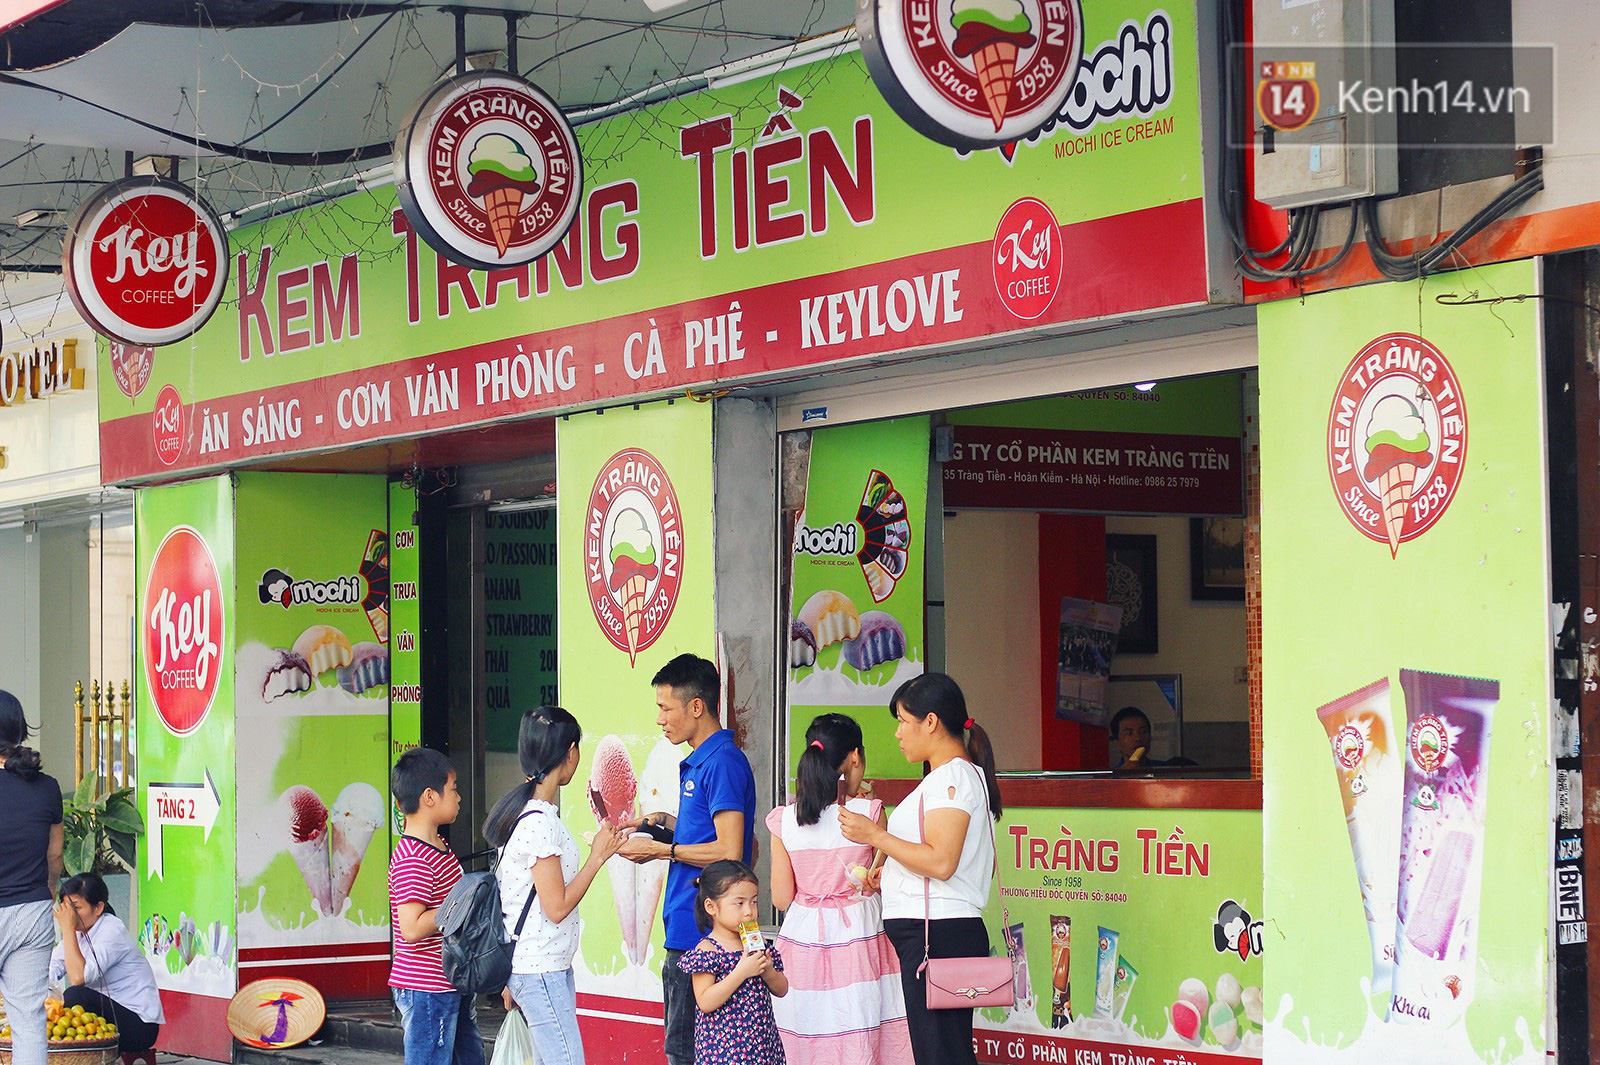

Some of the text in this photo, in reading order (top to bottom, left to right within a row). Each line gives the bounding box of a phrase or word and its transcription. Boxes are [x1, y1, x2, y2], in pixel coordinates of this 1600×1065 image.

[911, 0, 936, 48] KE
[931, 56, 1055, 103] Since 1958
[436, 125, 459, 187] KEM
[453, 93, 543, 131] TRÀNG
[1054, 116, 1174, 159] MOCHI ICE CREAM
[237, 243, 362, 363] KEM
[680, 84, 876, 261] TIỀN
[448, 198, 555, 236] Since 1958
[99, 224, 209, 299] Key
[997, 219, 1051, 274] Key
[121, 289, 175, 304] COFFEE
[1007, 275, 1051, 301] COFFEE
[199, 403, 230, 454] ĂN
[241, 396, 302, 447] SÁNG
[336, 380, 392, 430] CƠM
[404, 363, 460, 417] VĂN
[475, 343, 577, 406] PHÒNG
[623, 317, 667, 380] CÀ
[684, 300, 746, 369] PHÊ
[799, 268, 965, 350] KEYLOVE
[1132, 393, 1160, 402] 84040
[1333, 395, 1357, 475] KEM
[1350, 342, 1438, 390] TRÀNG
[159, 435, 179, 452] COFFEE
[967, 443, 992, 461] TY
[996, 439, 1023, 463] CỔ
[1027, 441, 1078, 465] PHẦN
[1083, 448, 1120, 466] KEM
[1124, 444, 1185, 469] TRÀNG
[1188, 447, 1230, 471] TIỀN
[944, 470, 956, 480] 35
[957, 469, 984, 484] Tràng
[1014, 471, 1038, 483] Hoàn
[1071, 473, 1084, 484] Hà
[1085, 473, 1101, 487] Nội
[1108, 475, 1142, 486] Hotline:
[1144, 476, 1166, 487] 0986
[1167, 477, 1178, 487] 25
[1180, 477, 1200, 488] 7979
[1344, 475, 1448, 527] Since 1958
[589, 506, 603, 584] KEM
[598, 456, 662, 502] TRÀNG
[394, 529, 415, 549] CƠM
[485, 542, 547, 565] O/PASSION
[292, 575, 360, 604] mochi
[393, 581, 417, 600] TRƯA
[485, 613, 553, 637] STRAWBERRY
[596, 588, 669, 636] Since 1958
[151, 587, 218, 691] Key
[396, 628, 415, 651] VĂN
[161, 668, 196, 690] COFFEE
[391, 680, 421, 703] PHÒNG
[486, 679, 511, 711] QUẢ
[157, 791, 195, 820] TẦNG 2
[1008, 824, 1210, 878] TRÀNG TIỀN
[1030, 886, 1048, 900] HIỆU
[1105, 892, 1128, 903] 84040
[1042, 875, 1082, 888] Since 1958
[1559, 871, 1580, 917] BNE
[984, 1039, 1001, 1057] TY
[1007, 1037, 1025, 1060] CỔ
[1032, 1040, 1068, 1064] PHẦN
